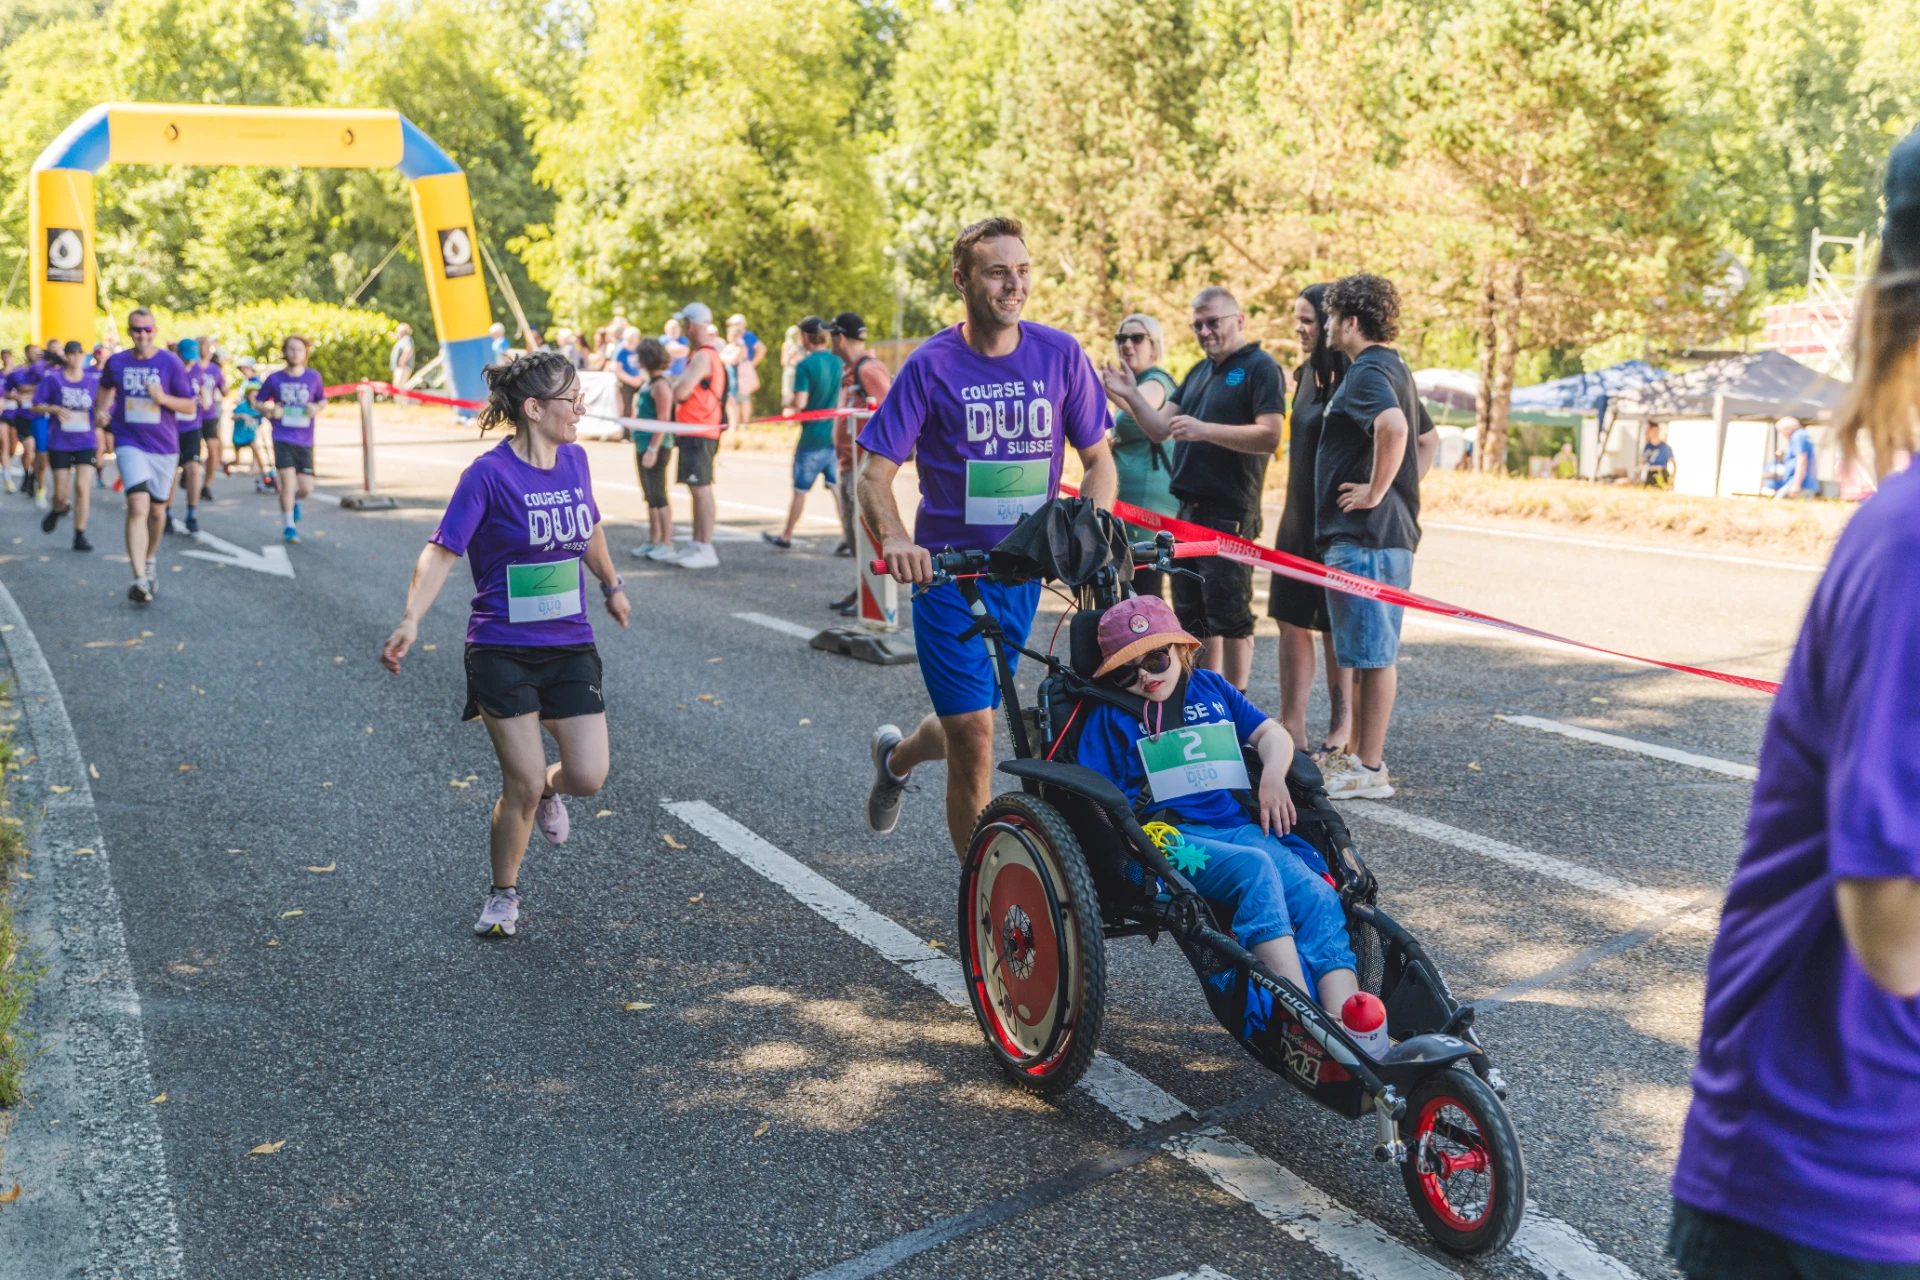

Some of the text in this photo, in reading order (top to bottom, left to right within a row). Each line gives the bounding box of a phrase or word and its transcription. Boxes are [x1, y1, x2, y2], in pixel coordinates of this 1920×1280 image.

[961, 381, 1026, 400] COURSE
[965, 397, 1053, 442] DUO
[1007, 440, 1053, 454] SUISSE
[994, 465, 1025, 493] 2
[524, 489, 572, 507] COURSE
[998, 504, 1024, 516] DUO
[528, 503, 594, 545] DUO
[1122, 503, 1161, 527] RAIFFEISEN
[1216, 535, 1262, 560] RAIFFEISEN
[533, 565, 558, 589] 2
[538, 600, 561, 612] DUO
[1179, 730, 1207, 761] 2
[1186, 768, 1218, 783] DUO
[1280, 1037, 1321, 1085] M1
